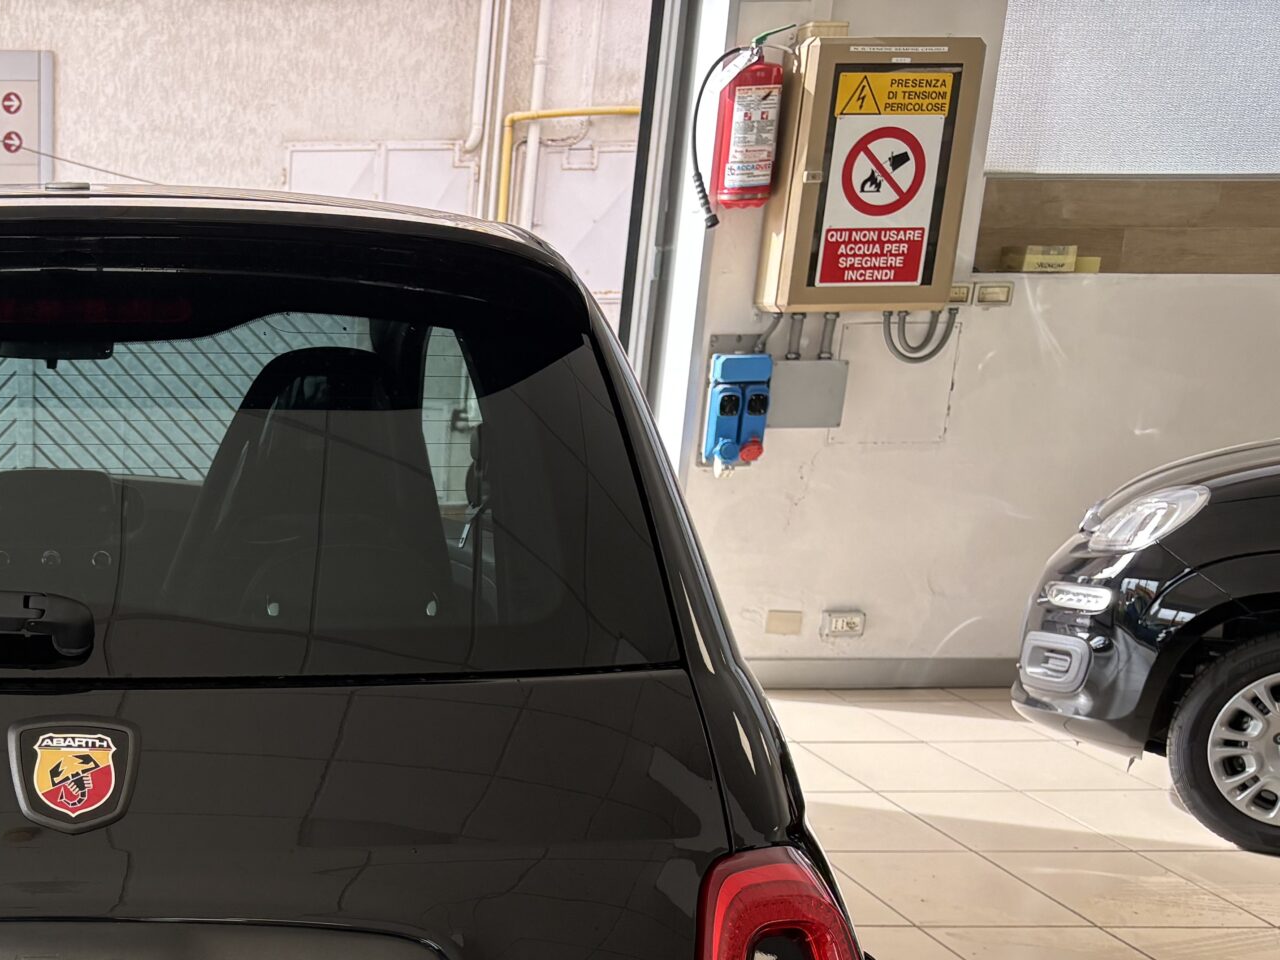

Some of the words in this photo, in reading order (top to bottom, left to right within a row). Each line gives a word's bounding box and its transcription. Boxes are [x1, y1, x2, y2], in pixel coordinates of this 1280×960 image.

[890, 78, 947, 88] PRESENZA
[887, 91, 897, 100] DI
[902, 91, 947, 100] TENSIONI
[884, 102, 947, 112] PERICOLOSE
[827, 231, 849, 242] QUI
[852, 230, 878, 241] NON
[881, 230, 922, 241] USARE
[838, 244, 880, 255] ACQUA
[884, 243, 908, 254] PER
[838, 256, 904, 267] SPEGNERE
[844, 270, 895, 280] INCENDI
[41, 738, 108, 748] ABARTH
